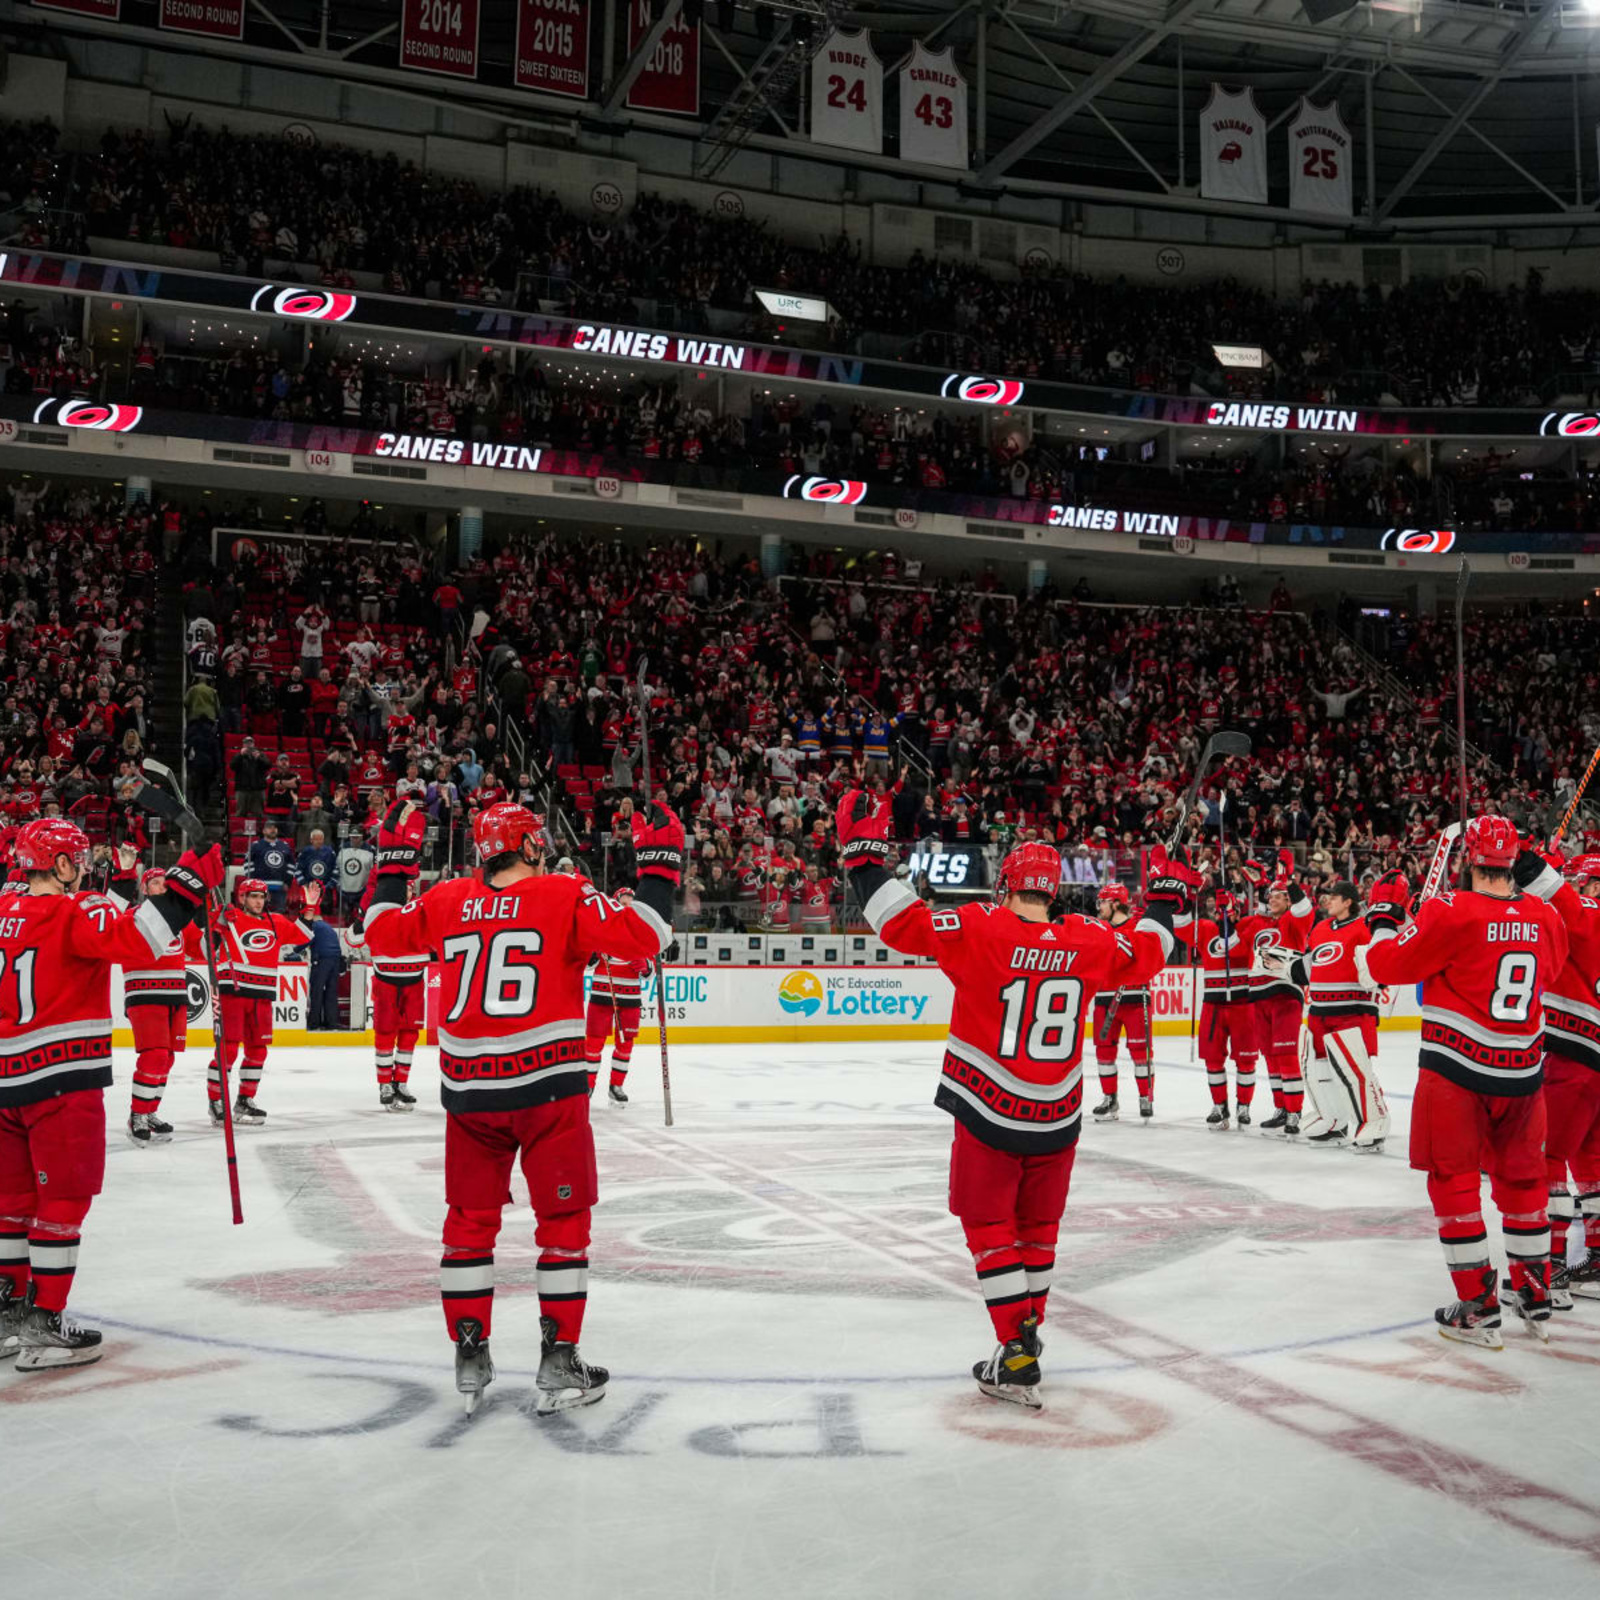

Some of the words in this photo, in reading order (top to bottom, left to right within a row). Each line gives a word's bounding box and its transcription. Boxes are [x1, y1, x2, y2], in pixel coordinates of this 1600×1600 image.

[165, 4, 203, 18] SECOND
[206, 9, 240, 25] ROUND
[419, 0, 462, 36] 2014
[533, 18, 573, 57] 2015
[405, 40, 441, 59] SECOND
[443, 46, 473, 65] ROUND
[829, 51, 868, 69] HODGE
[519, 59, 549, 79] SWEET
[550, 65, 585, 86] SIXTEEN
[910, 69, 957, 88] CHARLES
[828, 75, 867, 112] 24
[915, 93, 953, 129] 43
[1304, 147, 1338, 179] 25
[595, 191, 618, 205] 305
[719, 199, 742, 214] 305
[1160, 256, 1181, 268] 307
[573, 326, 669, 360] CANES
[676, 340, 744, 369] WIN
[1207, 402, 1290, 430] CANES
[1298, 408, 1357, 433] WIN
[309, 454, 331, 467] 104
[375, 433, 464, 463] CANES
[471, 443, 541, 471] WIN
[597, 480, 618, 493] 105
[898, 510, 915, 523] 106
[1048, 504, 1118, 531] CANES
[1122, 510, 1179, 536] WIN
[1174, 537, 1191, 550] 107
[842, 839, 889, 856] BAUER
[1496, 839, 1503, 850] 8
[1036, 875, 1048, 888] 18
[460, 899, 520, 923] SKJEI
[584, 891, 625, 922] 76
[1486, 921, 1540, 943] BURNS
[1009, 945, 1078, 973] DRURY
[443, 929, 543, 1023] 76
[827, 977, 845, 989] NC
[848, 976, 902, 989] Education
[1490, 950, 1538, 1023] 8
[827, 990, 928, 1021] Lottery
[1000, 975, 1084, 1063] 18
